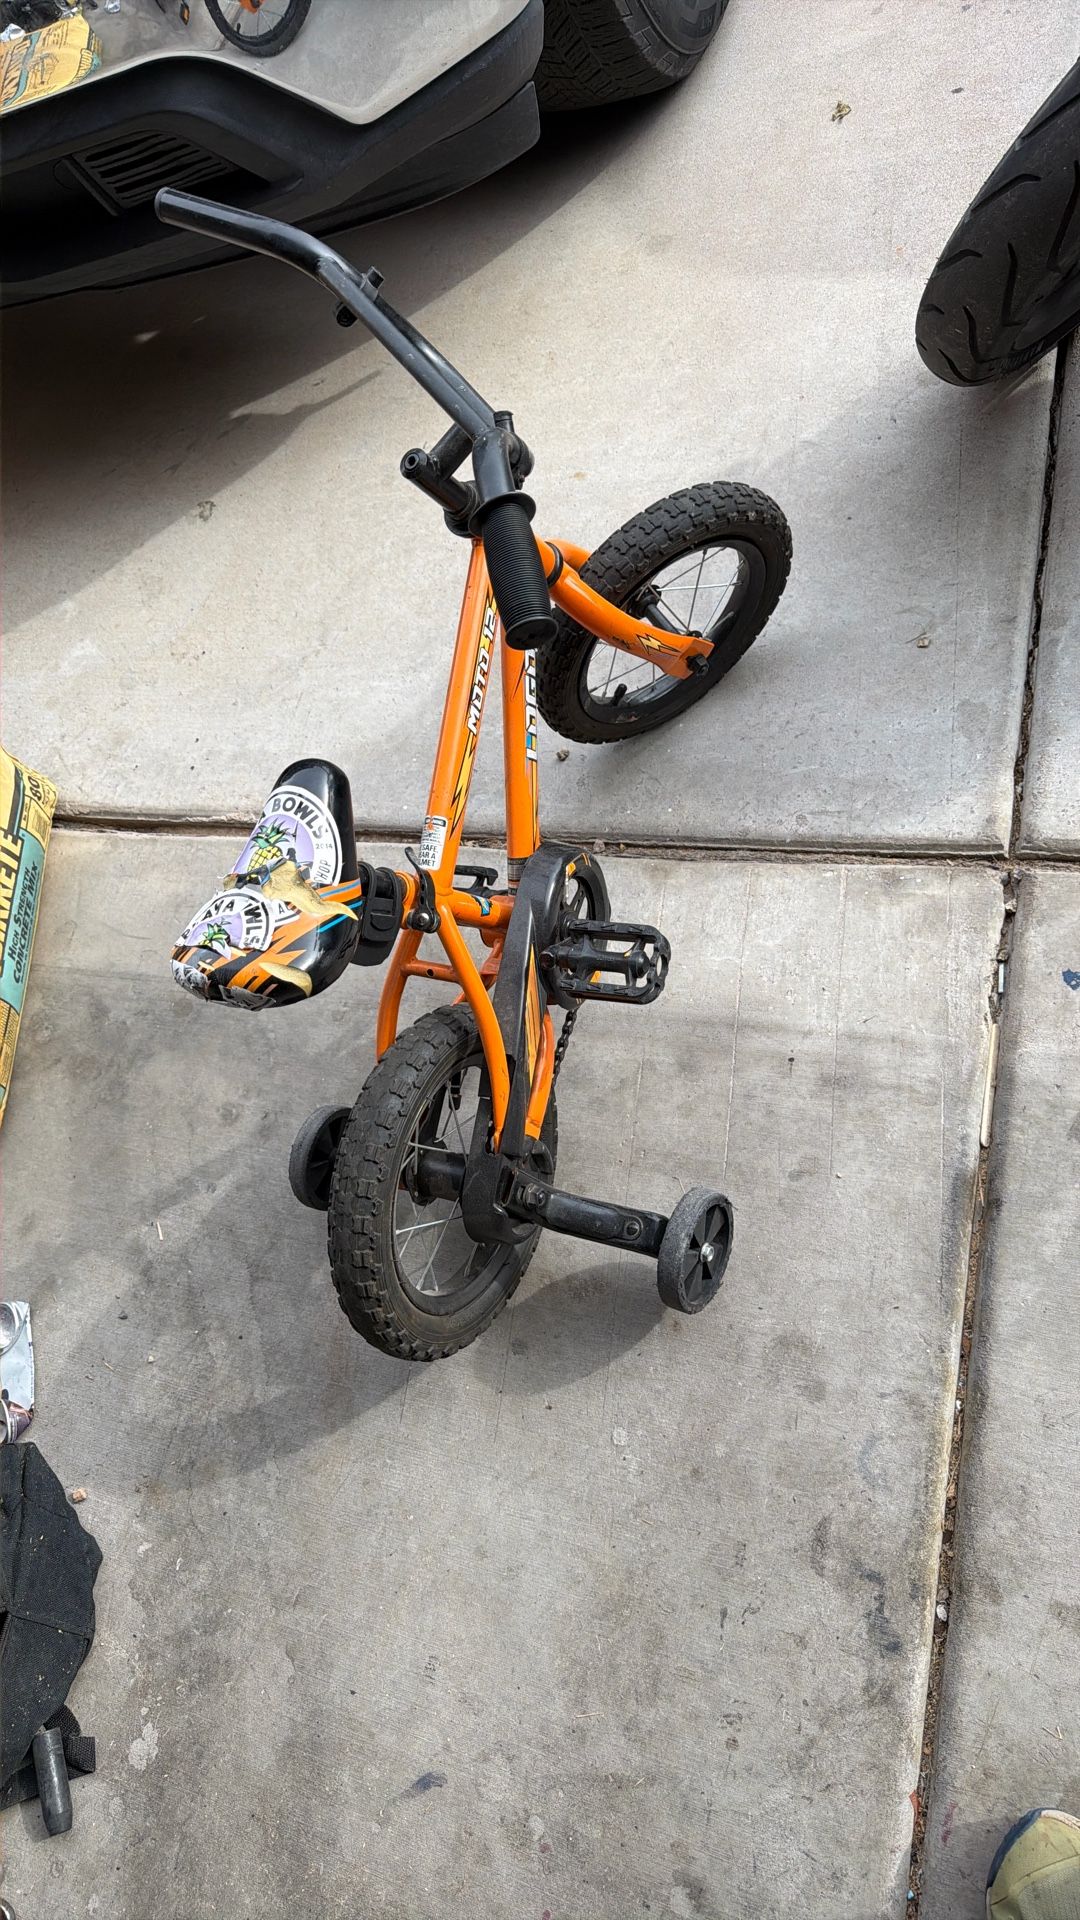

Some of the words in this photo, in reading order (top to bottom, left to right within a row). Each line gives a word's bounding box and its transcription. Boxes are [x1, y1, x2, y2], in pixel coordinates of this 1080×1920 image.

[467, 647, 490, 736] MOTO
[483, 607, 496, 641] 12
[28, 776, 42, 801] 80
[271, 797, 323, 839] BOWLS
[8, 930, 19, 961] HIGH
[14, 867, 30, 928] STRENGTH
[13, 898, 32, 985] CONCRETE
[27, 860, 38, 897] MIX
[181, 899, 235, 940] PAYA
